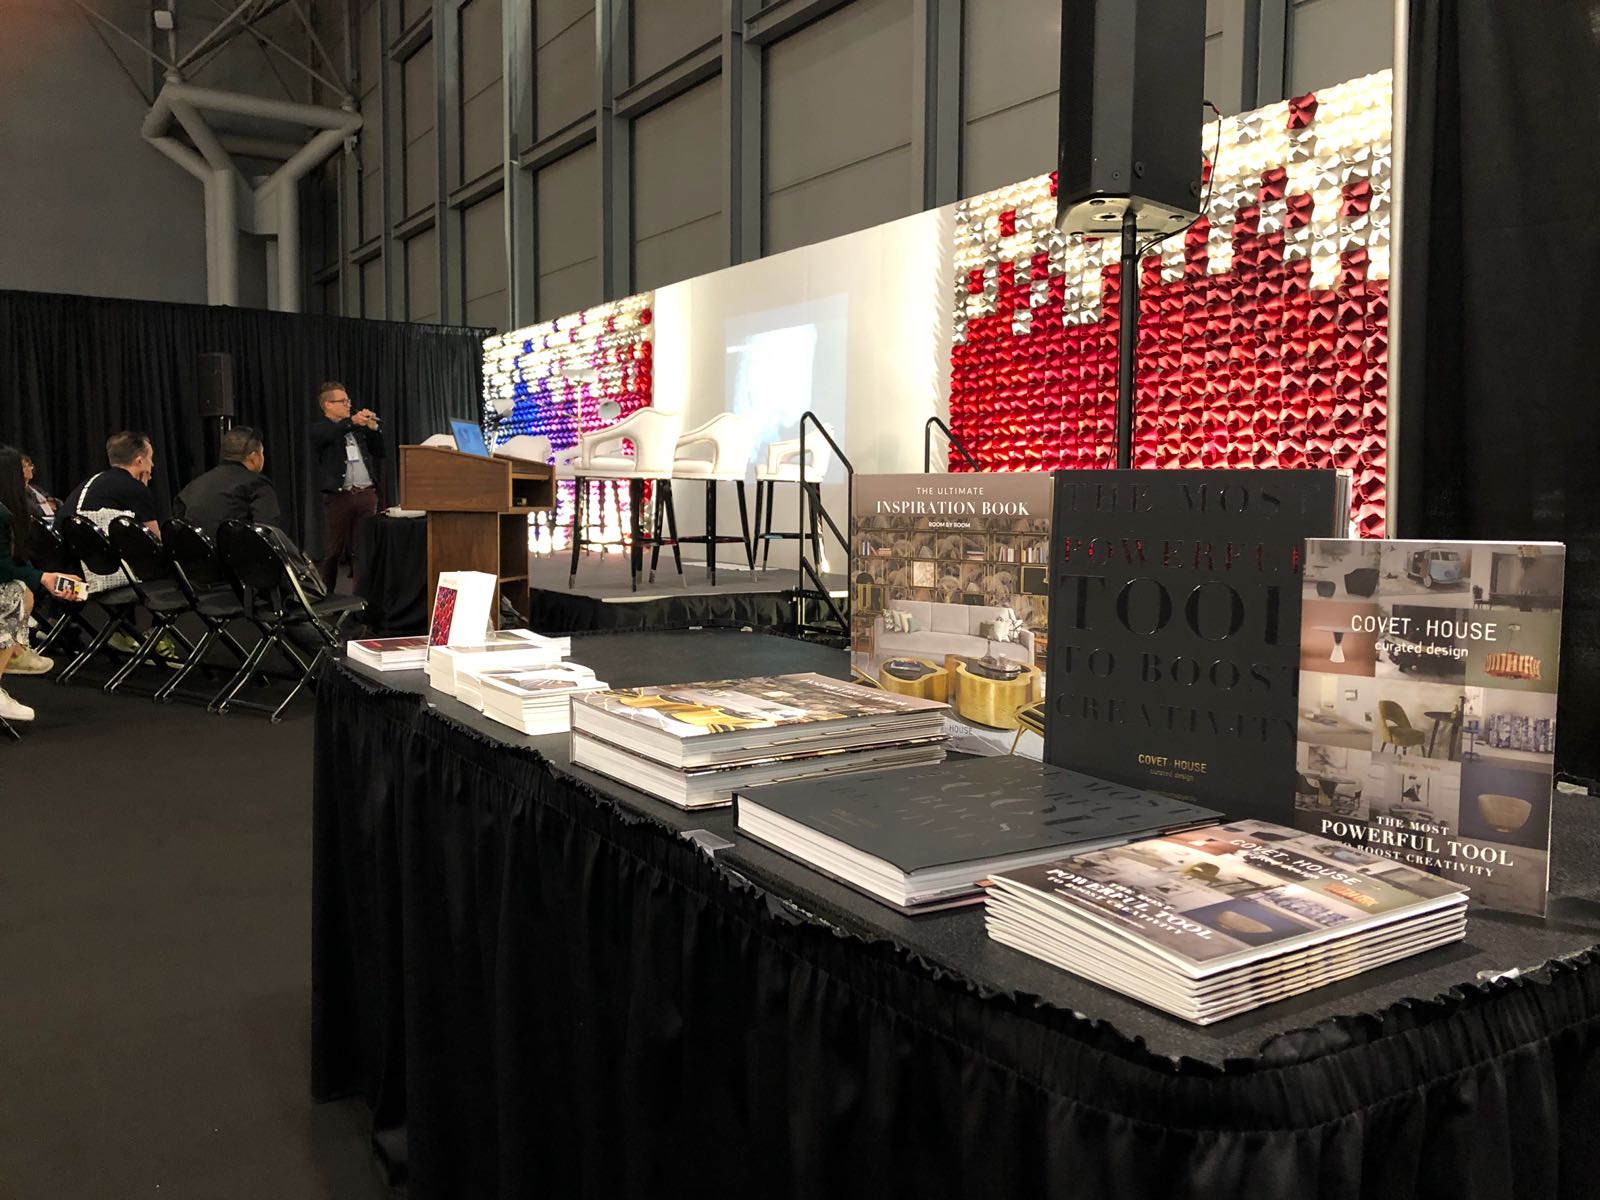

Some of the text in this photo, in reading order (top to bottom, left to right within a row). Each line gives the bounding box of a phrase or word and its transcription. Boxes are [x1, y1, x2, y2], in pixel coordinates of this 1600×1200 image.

[916, 487, 984, 496] THE ULTIMATE
[876, 500, 1030, 516] INSPIRATION BOOK
[1351, 614, 1498, 642] COVET HOUSE
[1058, 645, 1116, 678] TO
[1374, 641, 1469, 660] curated design
[949, 725, 974, 736] HOUSE
[1138, 753, 1208, 774] COVET HOUSE
[1376, 815, 1450, 836] THE MOST
[1321, 819, 1514, 867] POWERFUL TOOL
[1229, 839, 1364, 886] COVET HOUSE
[1406, 853, 1495, 877] CREATIVITY
[1046, 868, 1214, 940] POWERFUL TOOL
